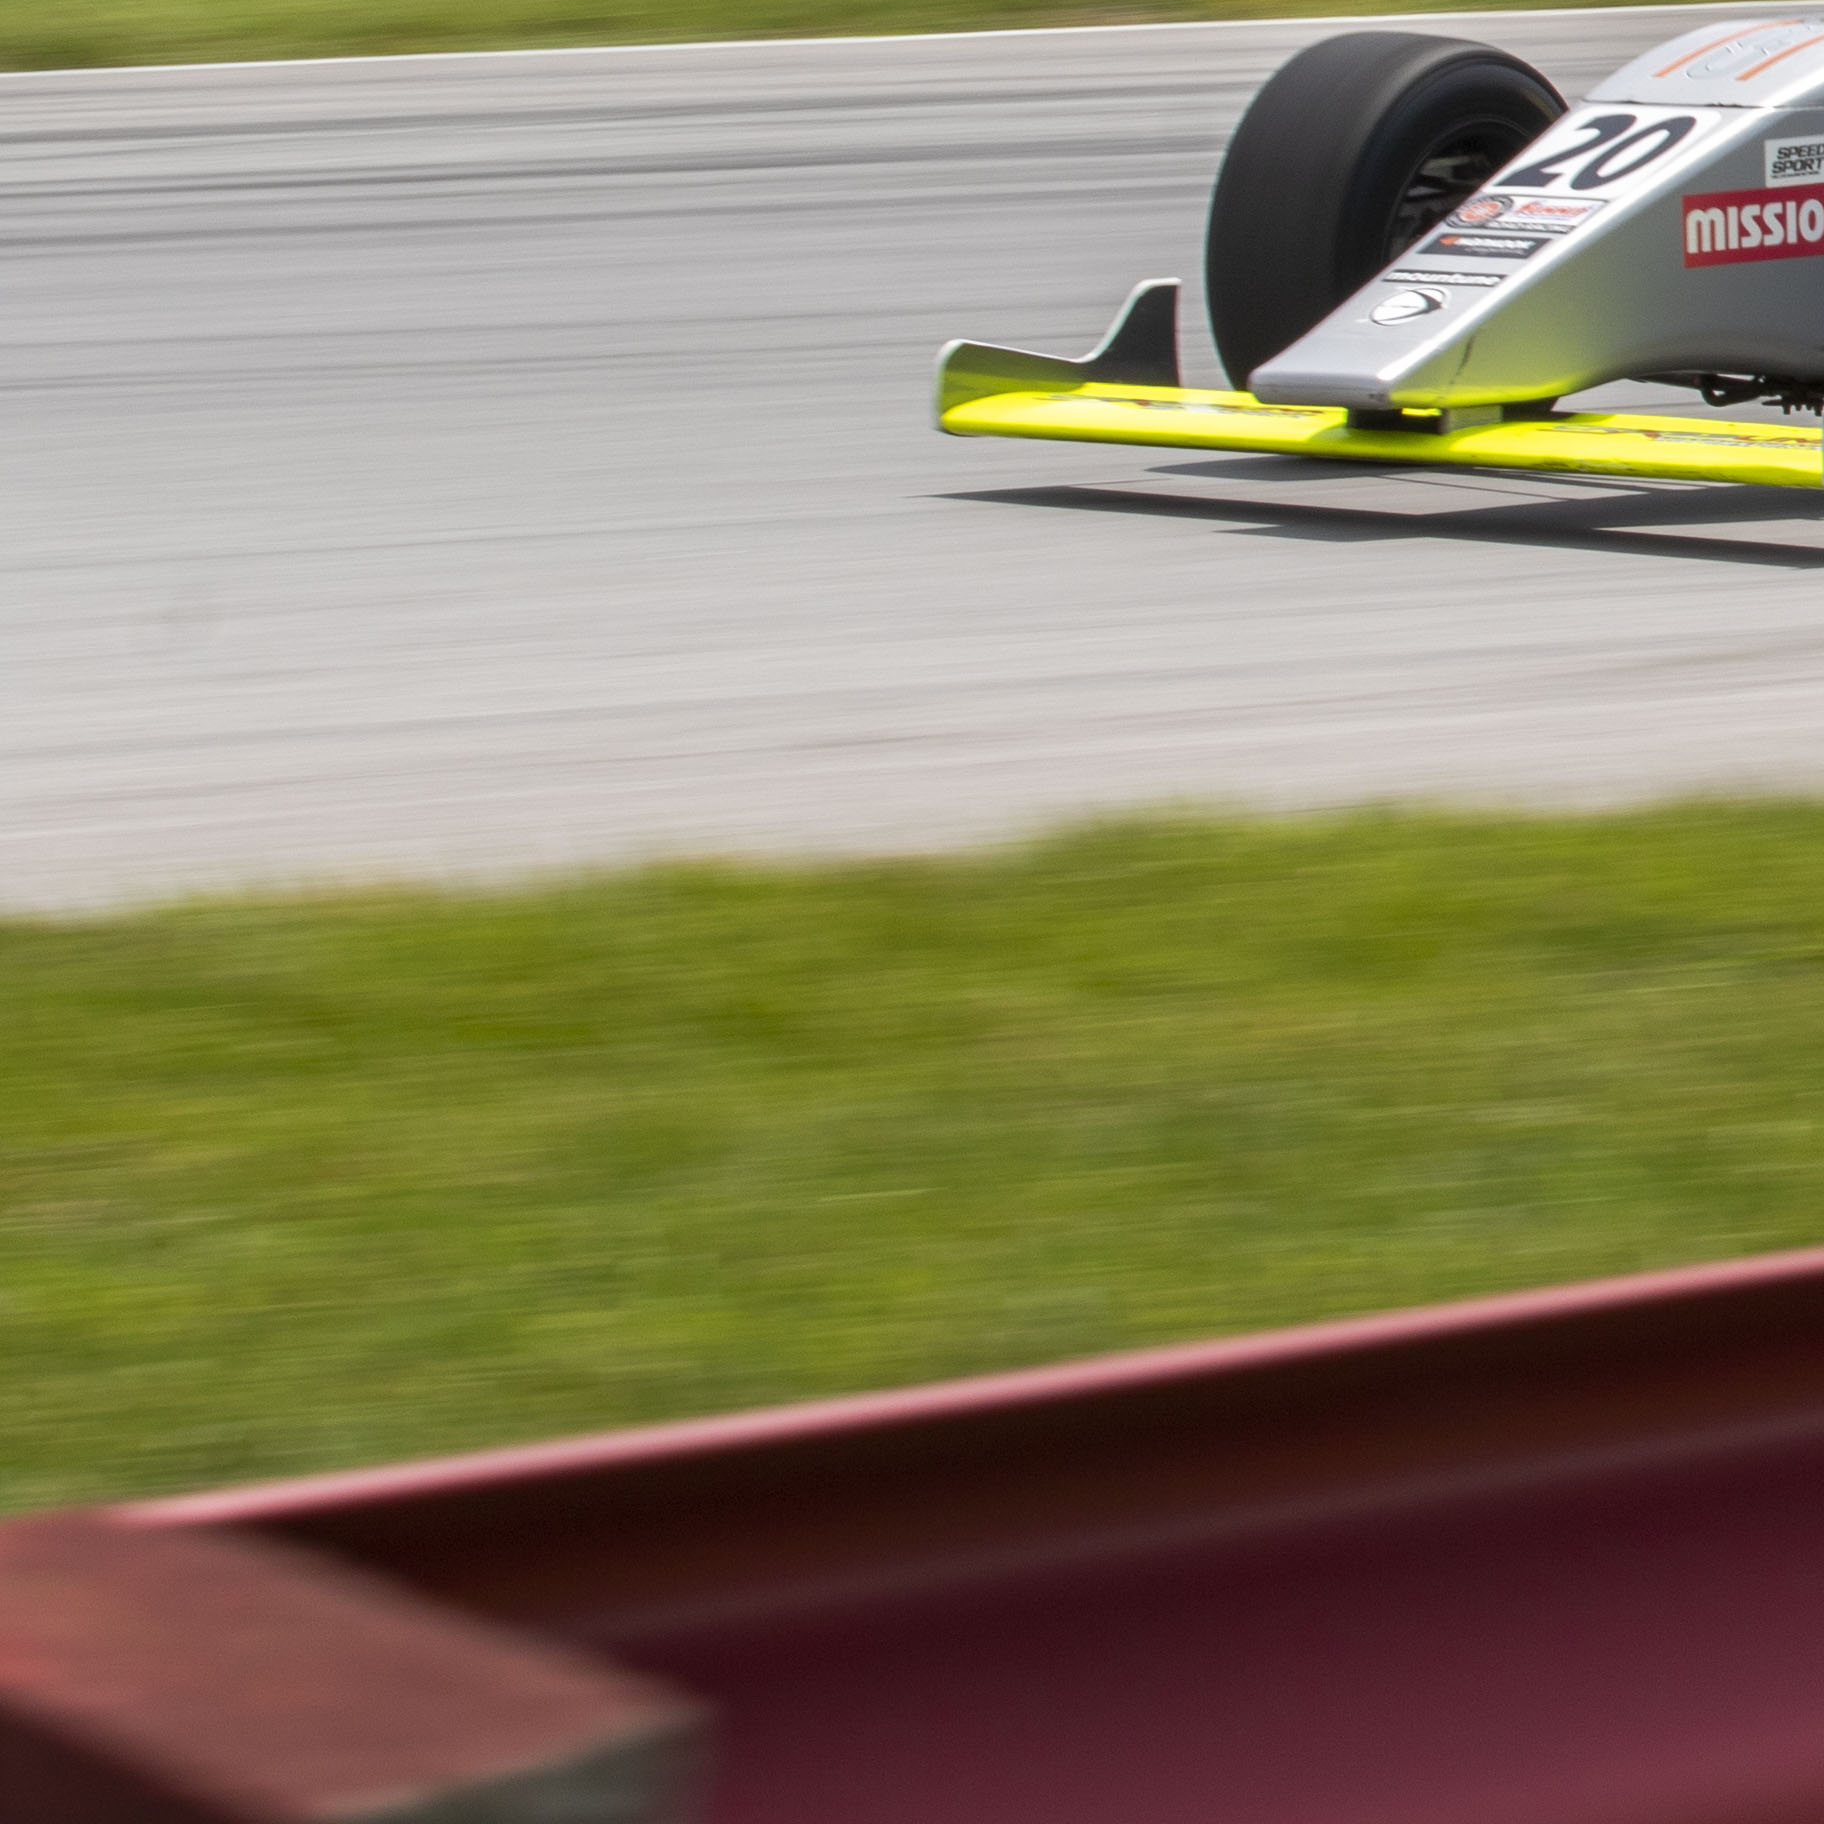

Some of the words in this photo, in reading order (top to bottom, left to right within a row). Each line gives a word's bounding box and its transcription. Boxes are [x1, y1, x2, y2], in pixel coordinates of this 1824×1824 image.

[1493, 114, 1697, 190] 20
[1771, 158, 1824, 175] SPORT
[1386, 270, 1502, 286] mountune
